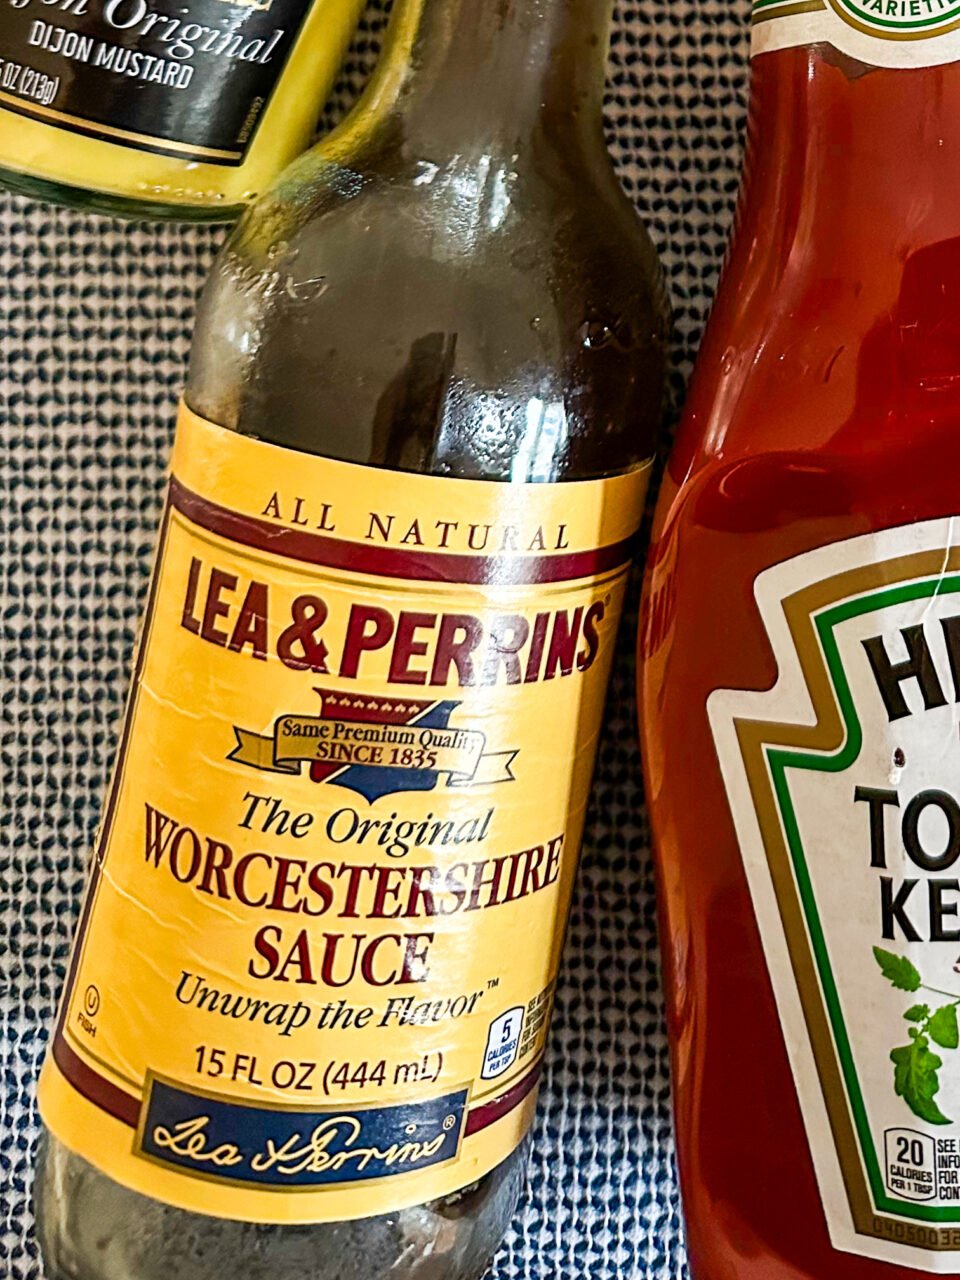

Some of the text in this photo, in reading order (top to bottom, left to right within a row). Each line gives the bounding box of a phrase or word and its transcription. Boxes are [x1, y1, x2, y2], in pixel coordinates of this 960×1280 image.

[29, 20, 195, 90] DIJON MUSTARD
[3, 62, 22, 90] OZ
[18, 66, 60, 106] (213g)
[261, 491, 573, 552] ALL NATURAL
[282, 719, 329, 739] Same
[333, 723, 415, 745] Premium
[316, 741, 438, 769] SINCE 1835
[238, 791, 496, 858] The Original
[143, 802, 565, 920] WORCESTERSHIRE
[248, 924, 435, 987] SAUCE
[174, 970, 314, 1037] Unwrap
[317, 999, 372, 1030] the
[194, 1044, 444, 1097] 15 FL OZ (444 mL)
[896, 1136, 924, 1167] 20
[937, 1139, 956, 1153] SEE
[890, 1164, 933, 1183] CALORIES
[938, 1170, 959, 1184] FOR
